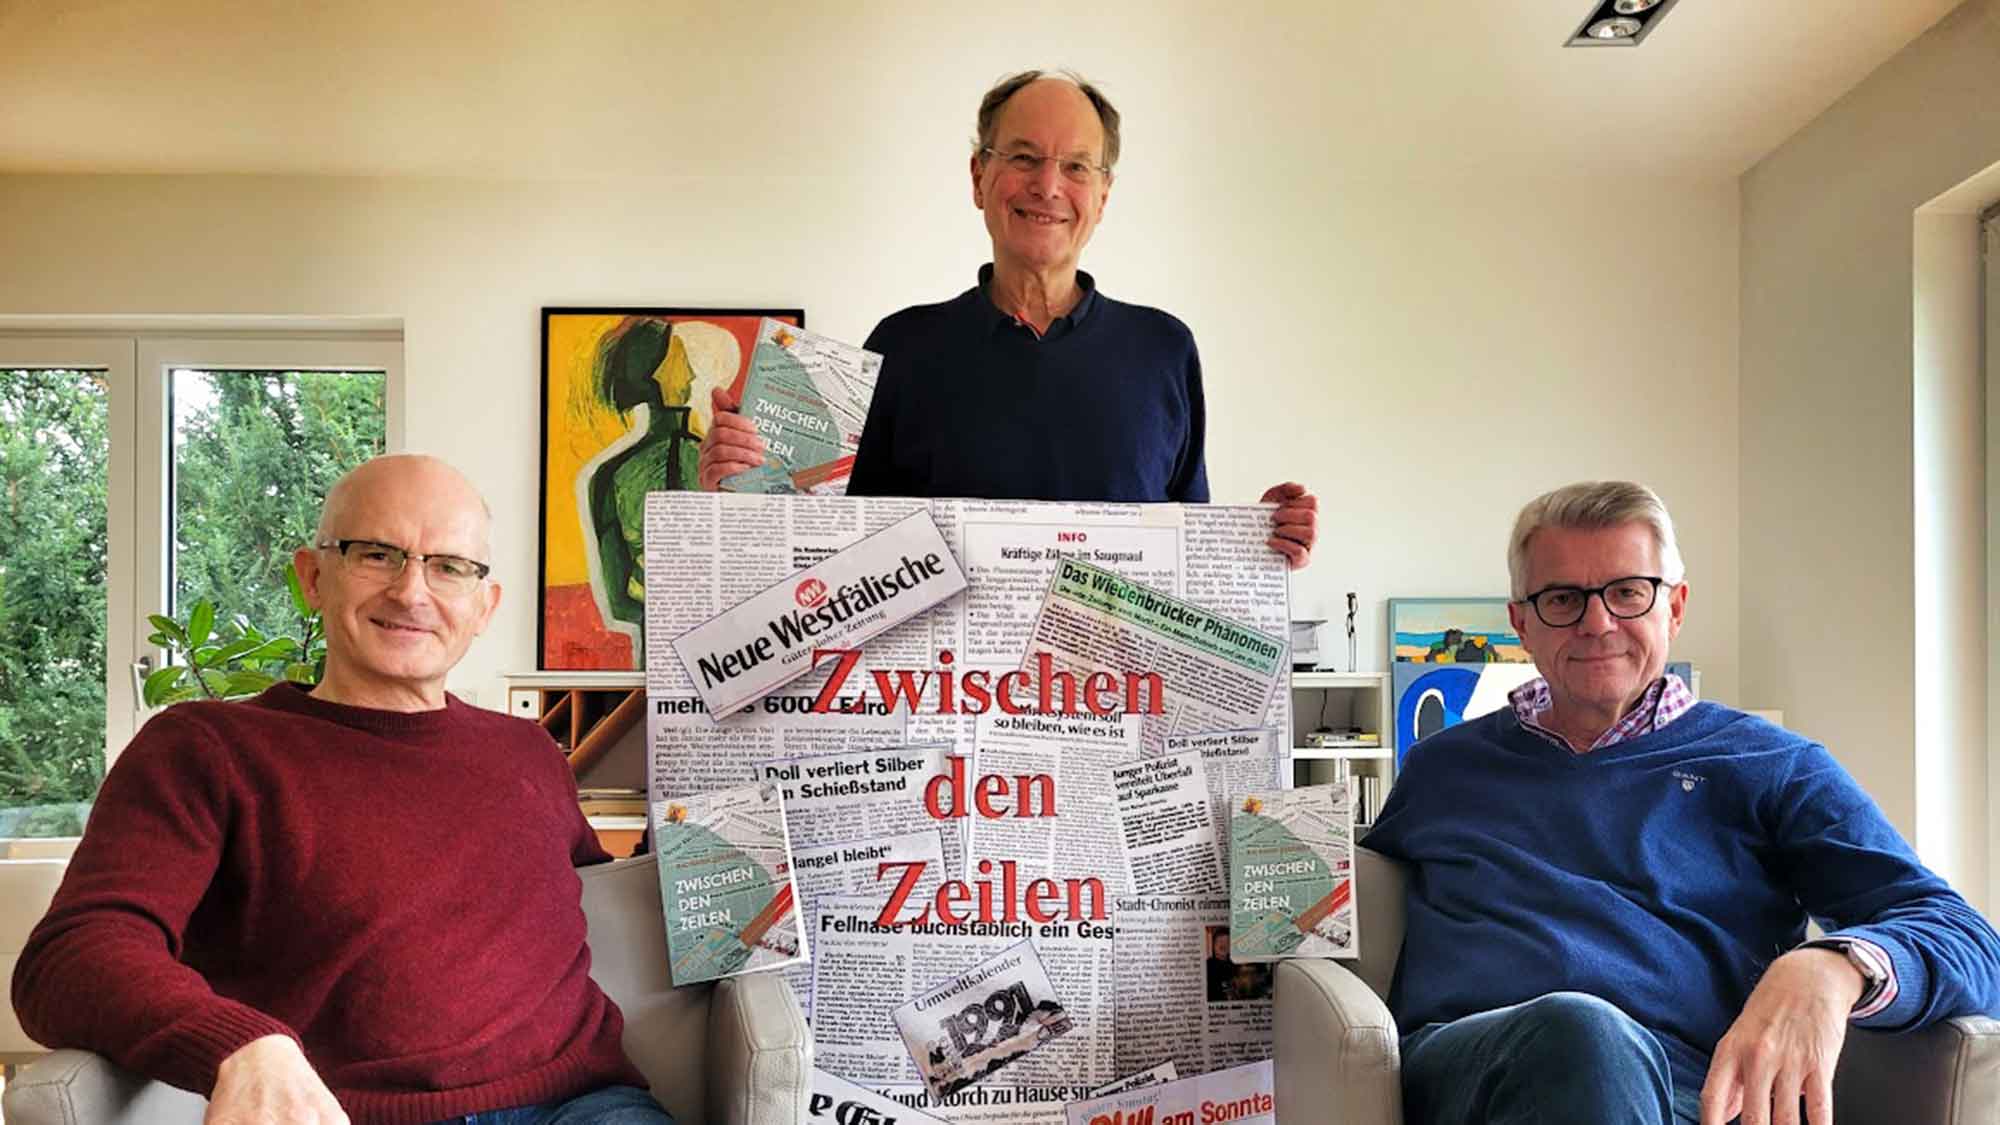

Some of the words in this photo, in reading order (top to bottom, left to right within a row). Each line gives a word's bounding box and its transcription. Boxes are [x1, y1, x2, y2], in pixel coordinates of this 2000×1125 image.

[753, 416, 784, 436] DEN
[755, 398, 829, 433] ZWISCHEN
[1057, 532, 1088, 543] INFO
[1001, 547, 1042, 562] Kräftige
[1094, 549, 1143, 564] Saugmaul
[1062, 563, 1089, 585] Das
[1092, 574, 1203, 629] Wiedenbrücker
[697, 632, 775, 690] Neue
[769, 551, 945, 650] Westfälische
[843, 610, 887, 635] Zeitung
[811, 649, 1166, 717] Zwischen
[656, 697, 710, 714] meh
[993, 718, 1010, 729] so
[1011, 718, 1065, 735] bleiben,
[1068, 723, 1091, 735] wie
[1093, 727, 1106, 737] es
[1108, 725, 1125, 738] ist
[766, 764, 800, 781] Doll
[806, 760, 870, 778] verliert
[875, 758, 925, 773] Silber
[801, 777, 907, 799] Schießstand
[924, 756, 1058, 821] den
[1243, 859, 1316, 879] ZWISCHEN
[675, 867, 754, 895] ZWISCHEN
[1244, 880, 1275, 894] DEN
[678, 894, 712, 912] DEN
[875, 858, 1110, 928] Zeilen
[1243, 895, 1291, 911] ZEILEN
[680, 908, 732, 931] ZEILEN
[821, 915, 904, 934] Fellnase
[1040, 920, 1069, 939] ein
[914, 955, 1022, 1013] Umweltkalender
[940, 981, 1036, 1058] 1991
[991, 1088, 1011, 1105] zu
[1015, 1086, 1068, 1103] Hause
[1162, 1109, 1194, 1125] am
[1201, 1092, 1274, 1124] Sonnta
